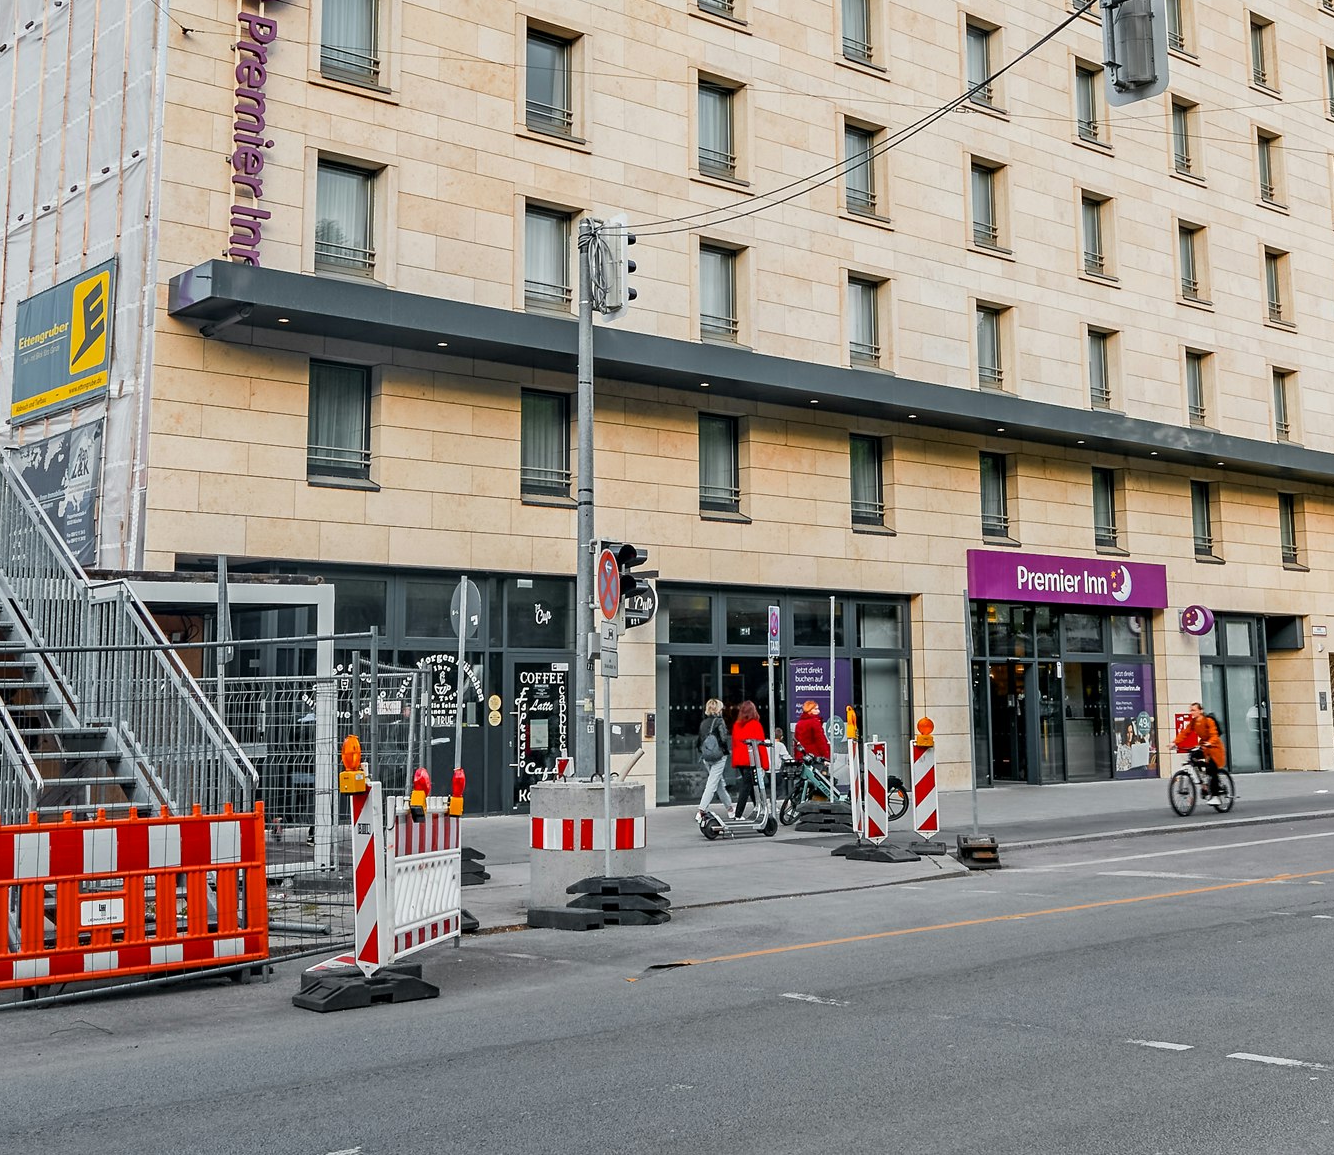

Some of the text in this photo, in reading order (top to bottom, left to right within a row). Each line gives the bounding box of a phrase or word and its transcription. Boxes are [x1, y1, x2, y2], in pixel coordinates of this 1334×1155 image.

[232, 12, 277, 198] Premier
[18, 321, 69, 350] Ettengruber
[1017, 565, 1108, 595] Premier Inn
[535, 609, 552, 625] Cup
[520, 672, 564, 684] COFFEE
[529, 699, 554, 711] Latte
[437, 715, 454, 725] TRUE
[514, 687, 530, 768] Espresso
